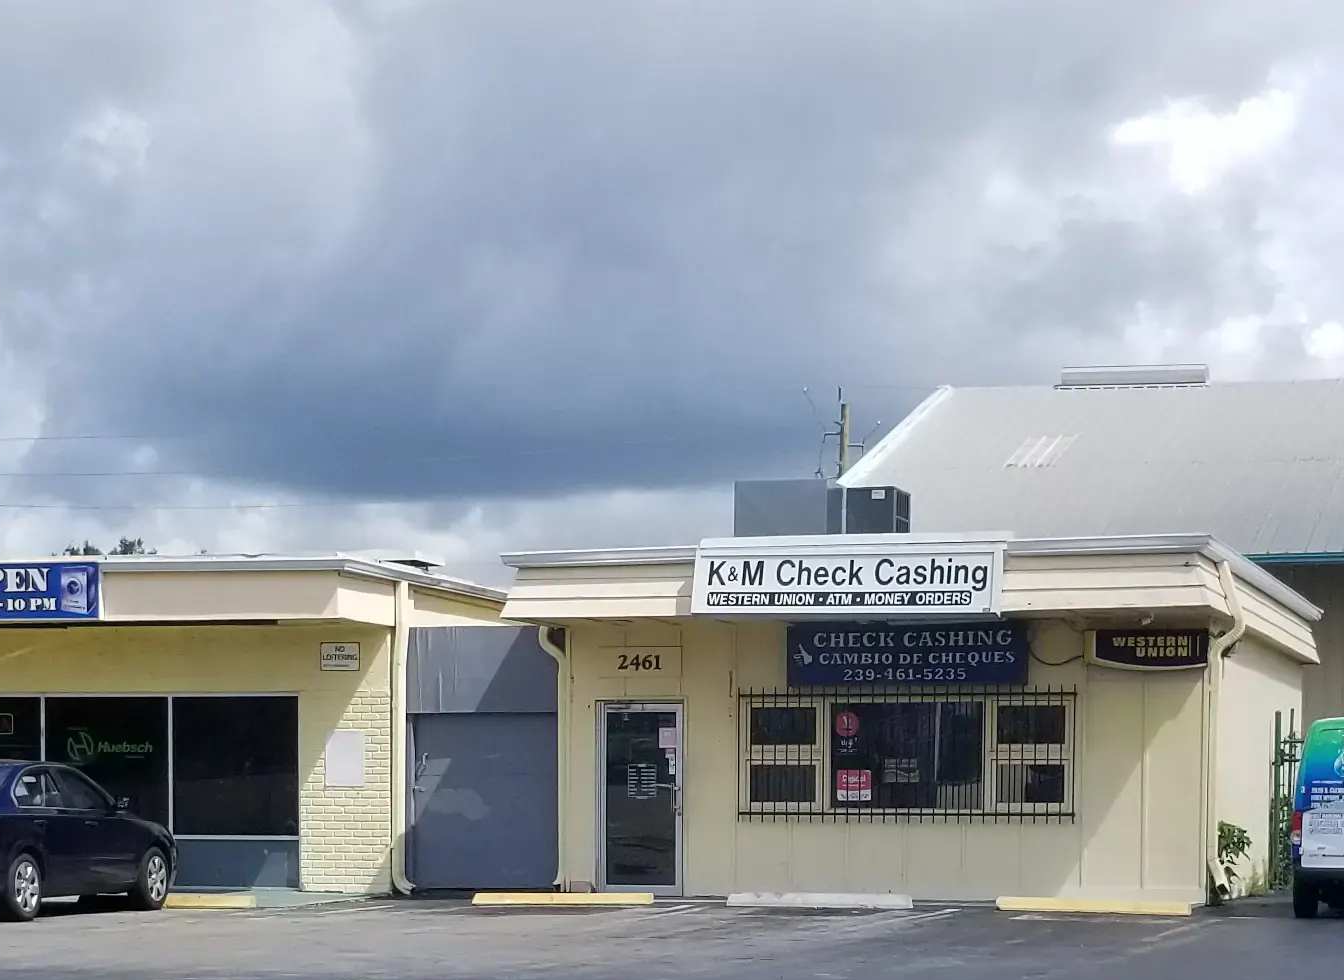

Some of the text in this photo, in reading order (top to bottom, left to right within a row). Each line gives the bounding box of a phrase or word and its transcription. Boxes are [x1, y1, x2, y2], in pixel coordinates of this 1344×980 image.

[707, 557, 988, 592] K&M Check Cashing
[6, 598, 26, 611] 10
[29, 597, 57, 611] PM
[708, 591, 971, 606] WESTERN UNION ATM MONEY ORDERS
[813, 629, 1013, 648] CHECK CASHING
[1112, 635, 1188, 647] WESTERN
[334, 645, 346, 653] NO
[1135, 646, 1188, 657] UNION
[617, 653, 662, 672] 2461
[818, 651, 1015, 667] CAMBIO DE CHEQUES
[843, 667, 966, 681] 239-461-5235
[97, 740, 154, 753] Huebsch
